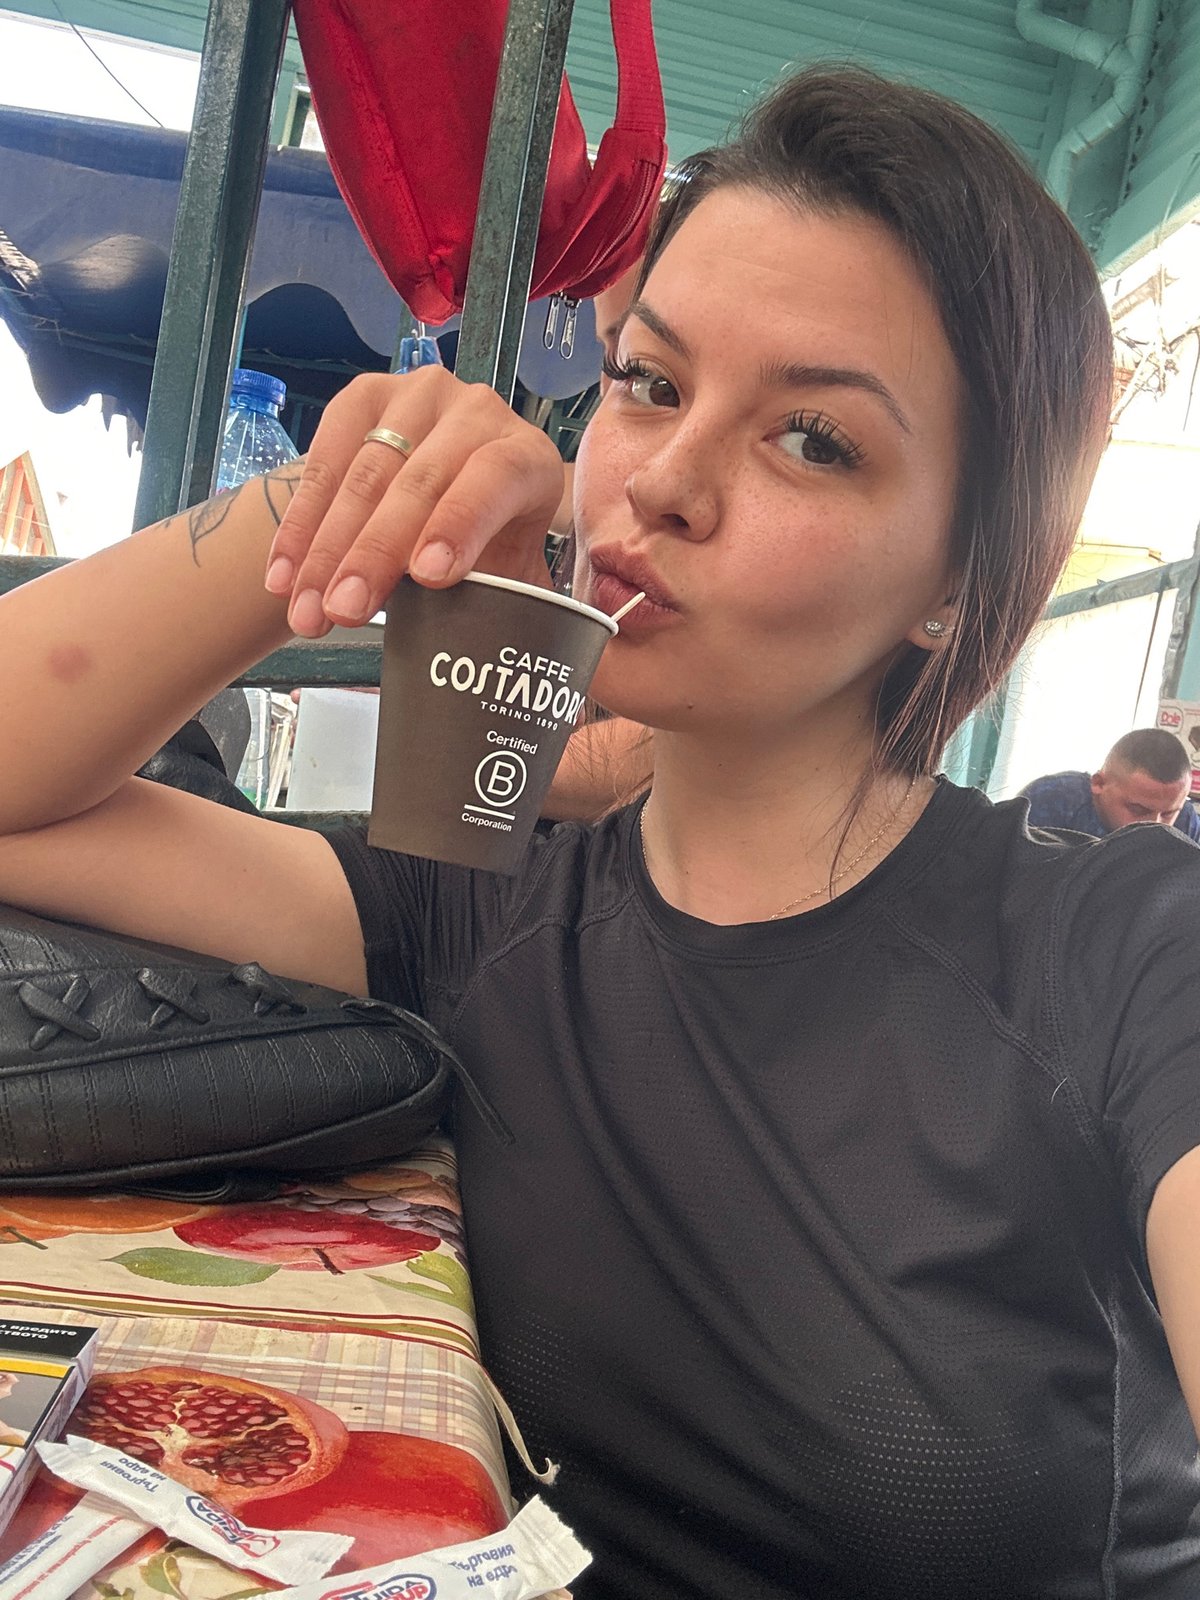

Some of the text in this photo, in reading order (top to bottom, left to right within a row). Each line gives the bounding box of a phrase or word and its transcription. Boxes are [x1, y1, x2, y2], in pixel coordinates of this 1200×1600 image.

[480, 701, 559, 731] TORINO 1890
[486, 730, 539, 755] Certified
[487, 761, 516, 796] B
[461, 812, 513, 832] Corporation
[10, 1325, 77, 1337] вредите
[100, 1460, 159, 1494] Търговия
[117, 1456, 167, 1483] на едро
[467, 1575, 484, 1588] на
